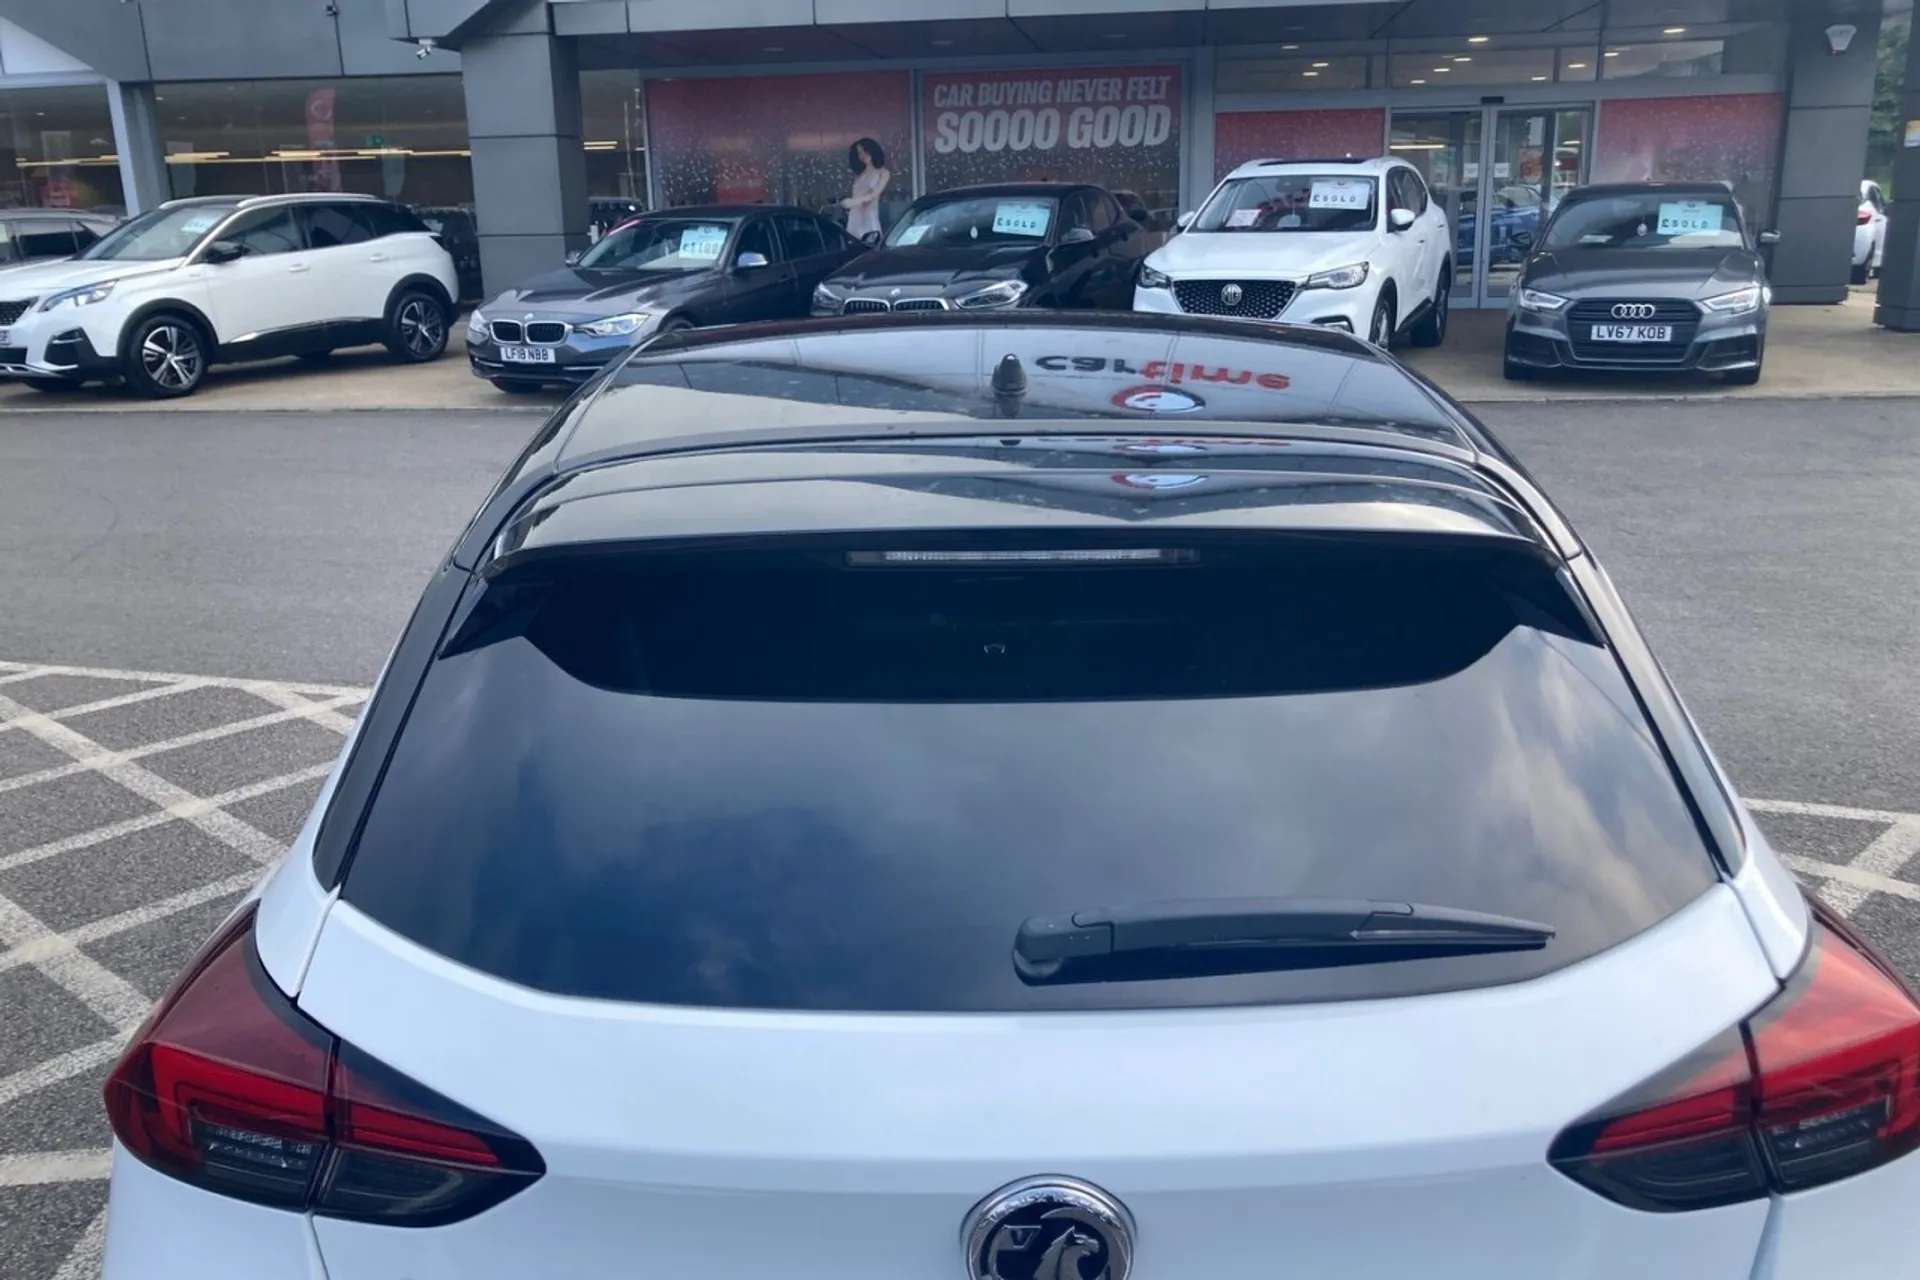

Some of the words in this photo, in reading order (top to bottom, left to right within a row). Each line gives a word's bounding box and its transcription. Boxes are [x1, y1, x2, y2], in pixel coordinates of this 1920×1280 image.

[934, 84, 974, 107] CAR
[978, 80, 1051, 105] BUYING
[1057, 77, 1121, 102] NEVER
[1126, 75, 1171, 100] FELT
[934, 107, 1061, 153] SOOOO
[1067, 104, 1172, 149] GOOD
[1596, 325, 1634, 339] LV67
[1637, 326, 1666, 339] KOB
